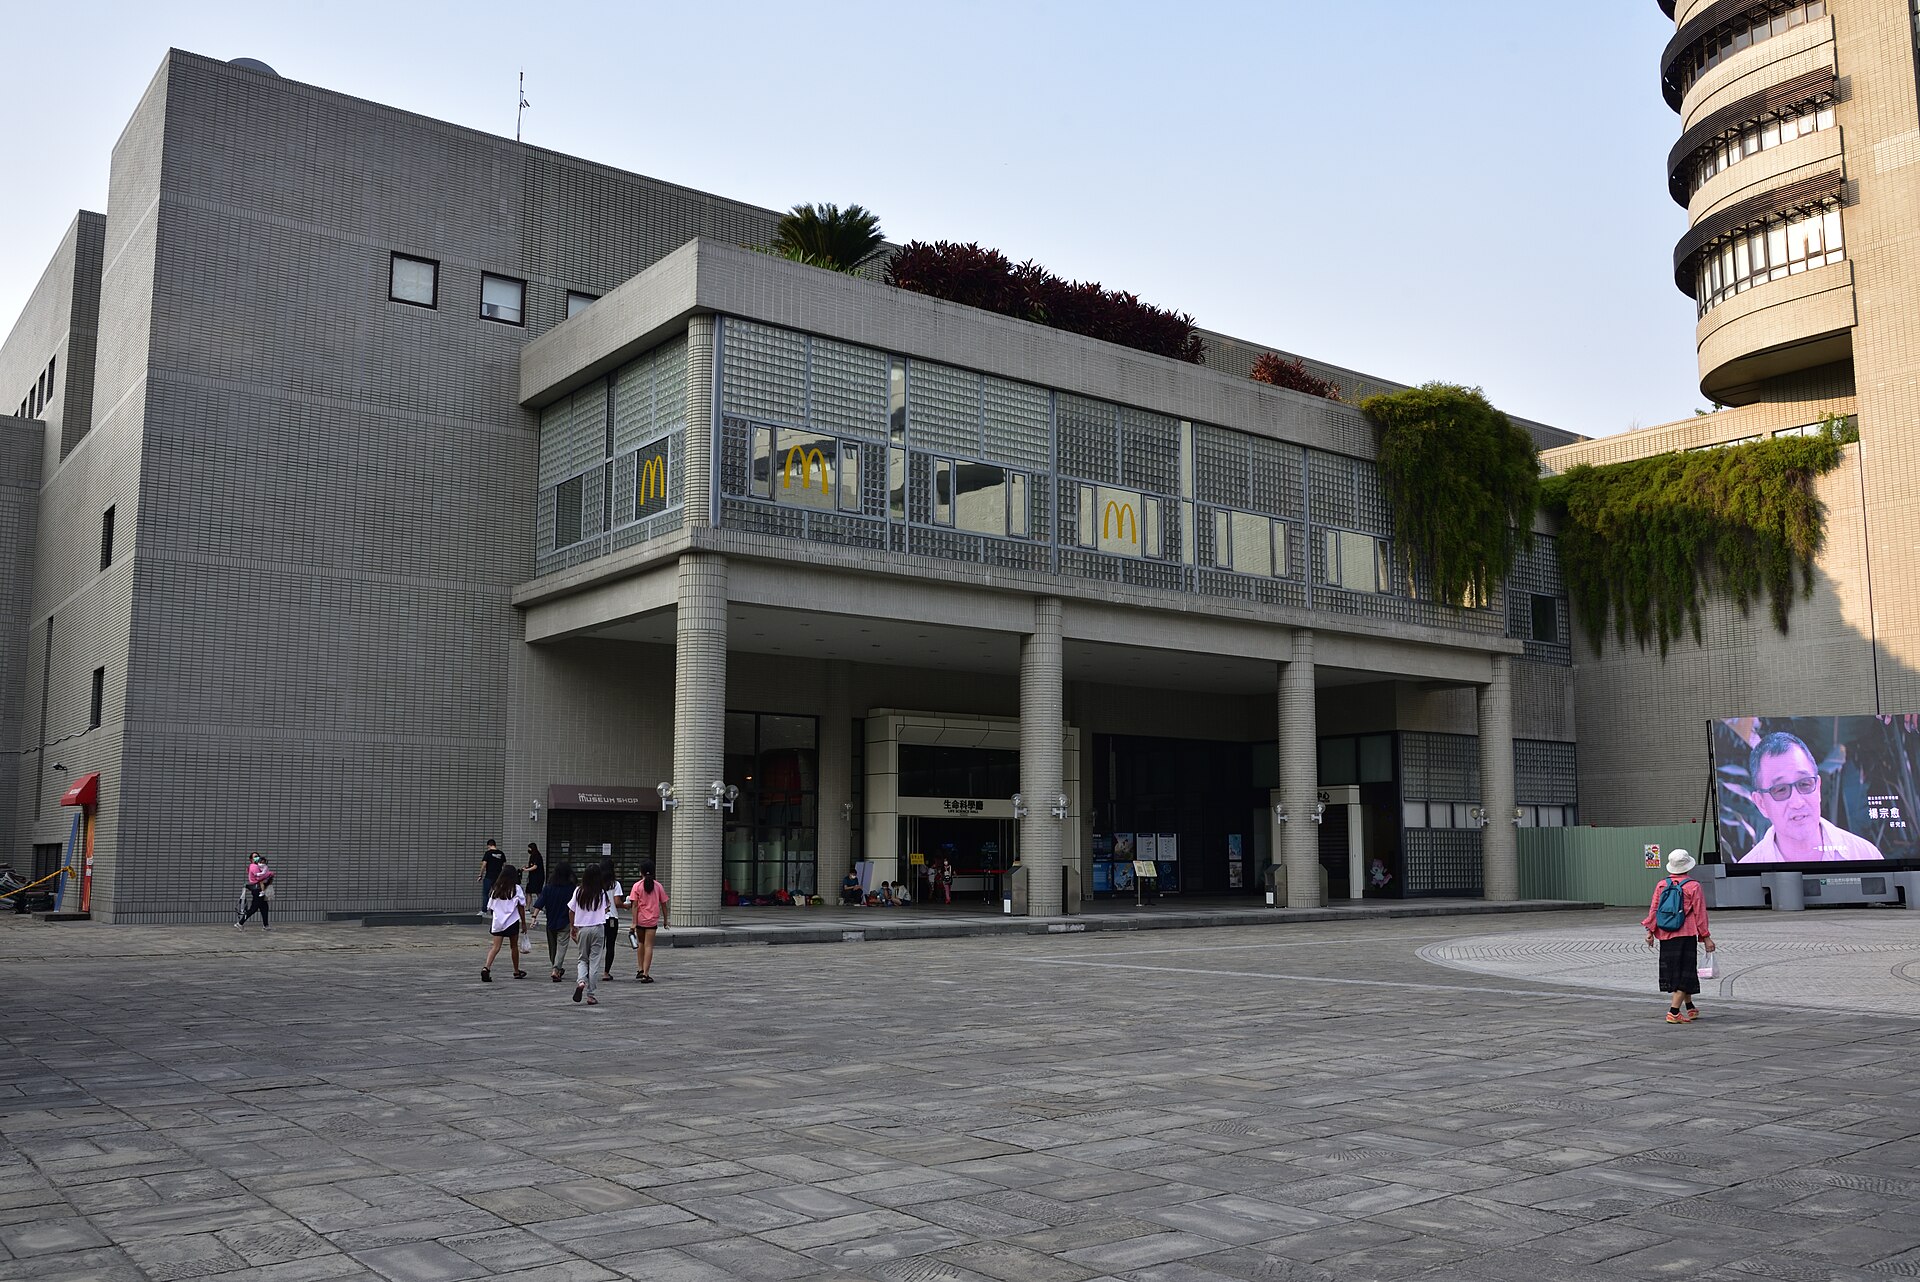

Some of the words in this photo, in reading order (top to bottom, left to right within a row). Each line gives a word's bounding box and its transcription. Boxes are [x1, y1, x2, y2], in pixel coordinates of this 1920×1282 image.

[944, 800, 984, 810] 生命科學廳
